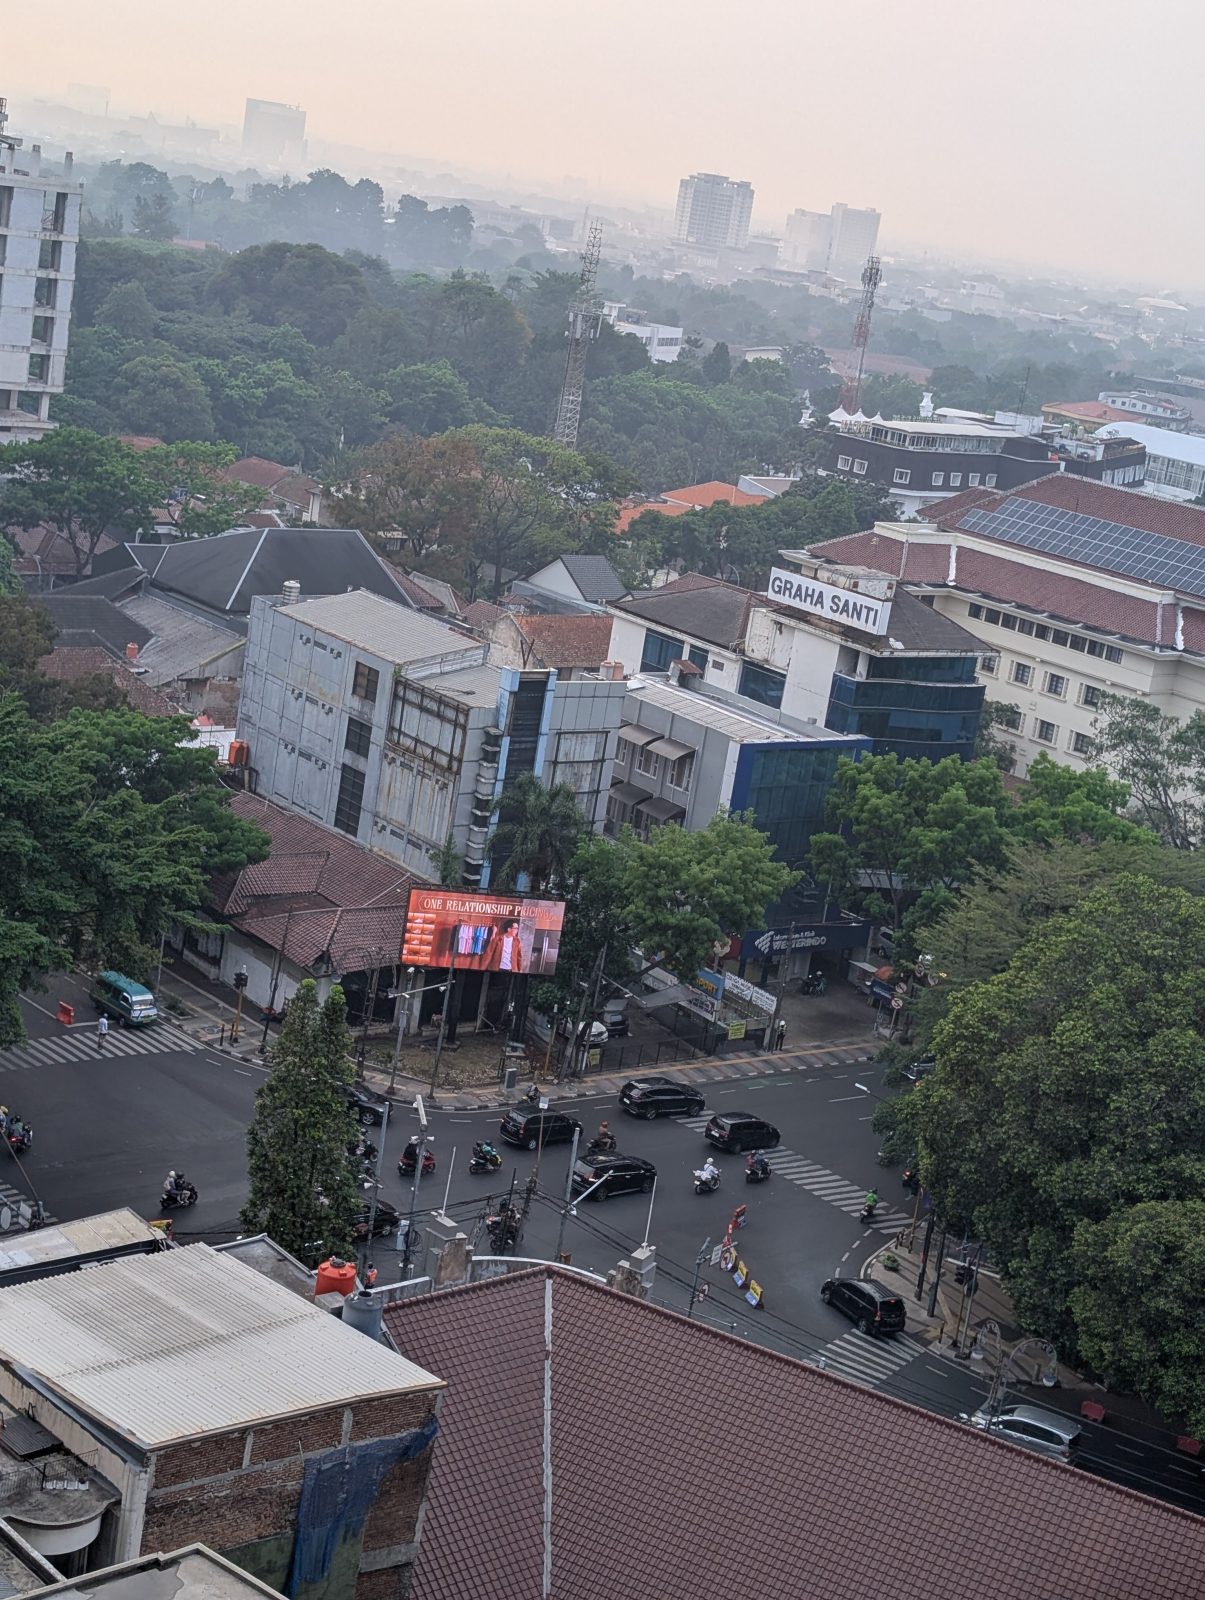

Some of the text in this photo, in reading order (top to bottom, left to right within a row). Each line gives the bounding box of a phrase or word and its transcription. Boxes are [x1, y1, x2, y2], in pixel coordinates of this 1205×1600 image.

[771, 576, 879, 627] GRAHA SANTI
[424, 898, 442, 910] ONE
[446, 900, 513, 915] RELATIONSHIP
[772, 936, 826, 950] WETERINDO
